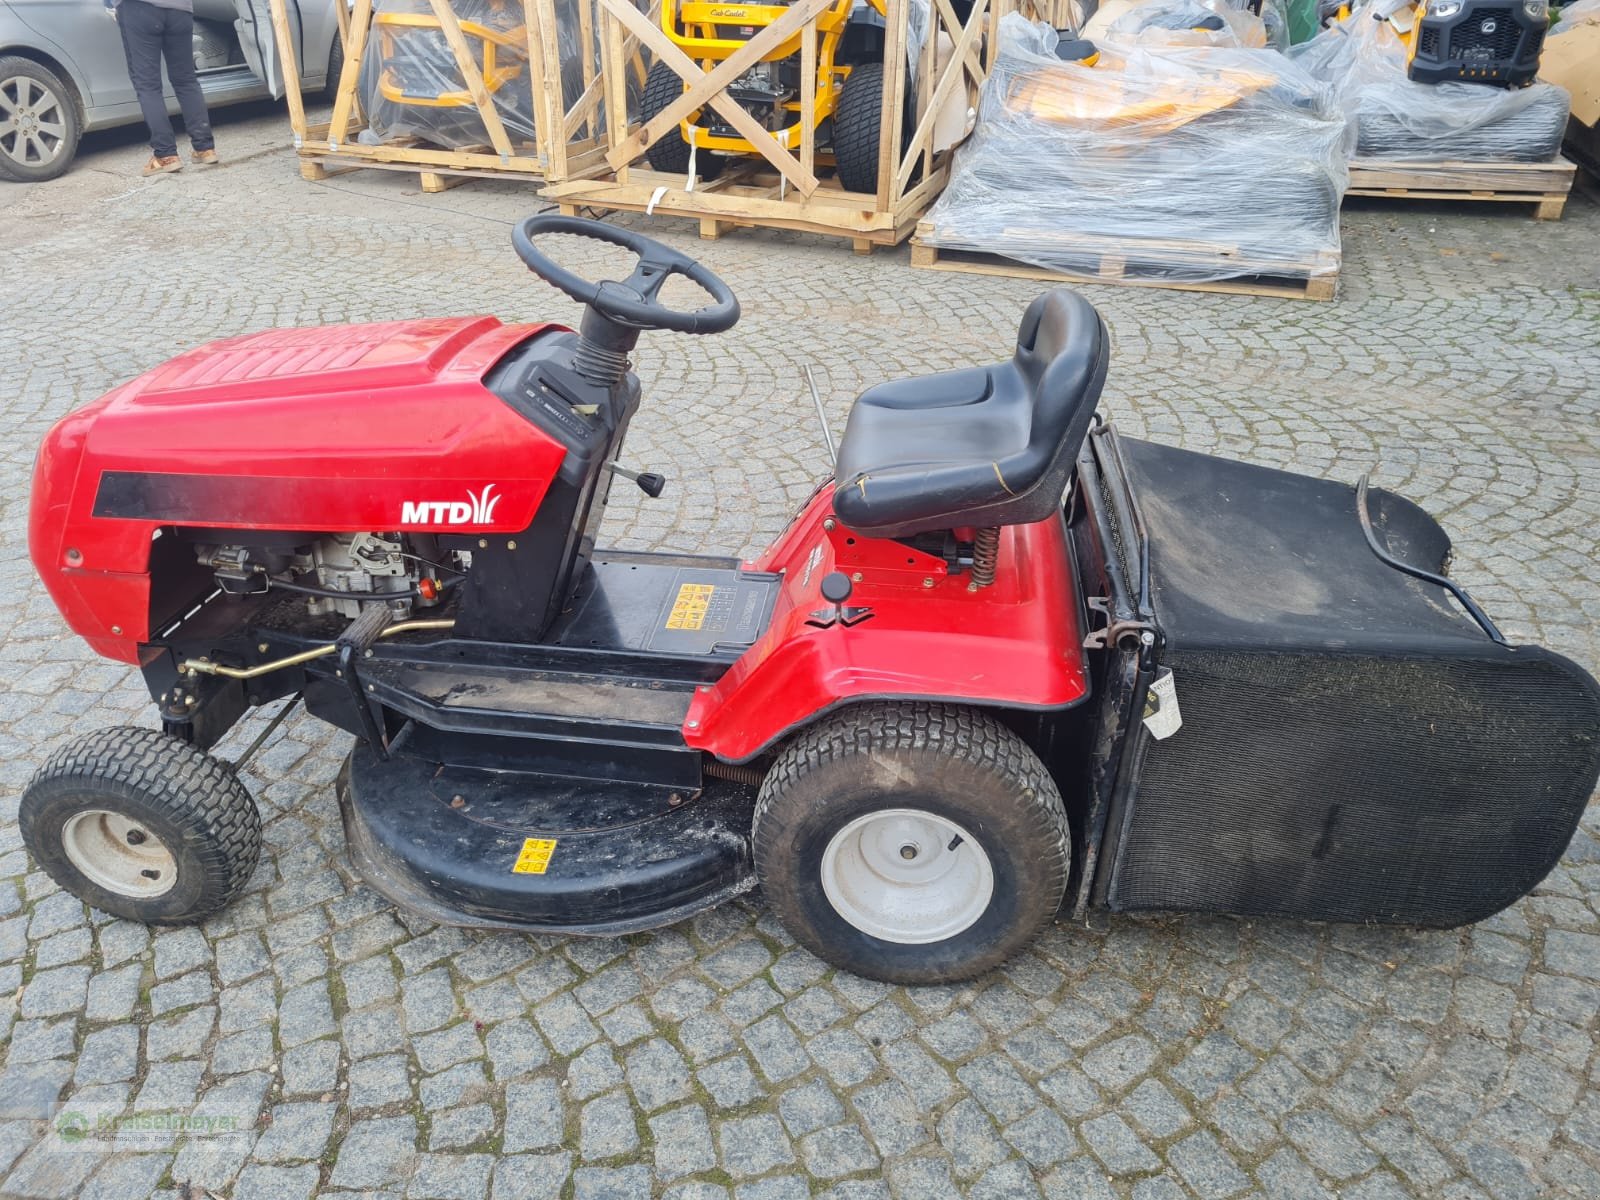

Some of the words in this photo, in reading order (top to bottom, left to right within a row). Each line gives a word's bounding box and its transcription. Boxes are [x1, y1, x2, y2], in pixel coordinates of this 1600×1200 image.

[710, 8, 724, 16] Cub
[724, 9, 746, 17] Cadet
[401, 501, 472, 524] MTD
